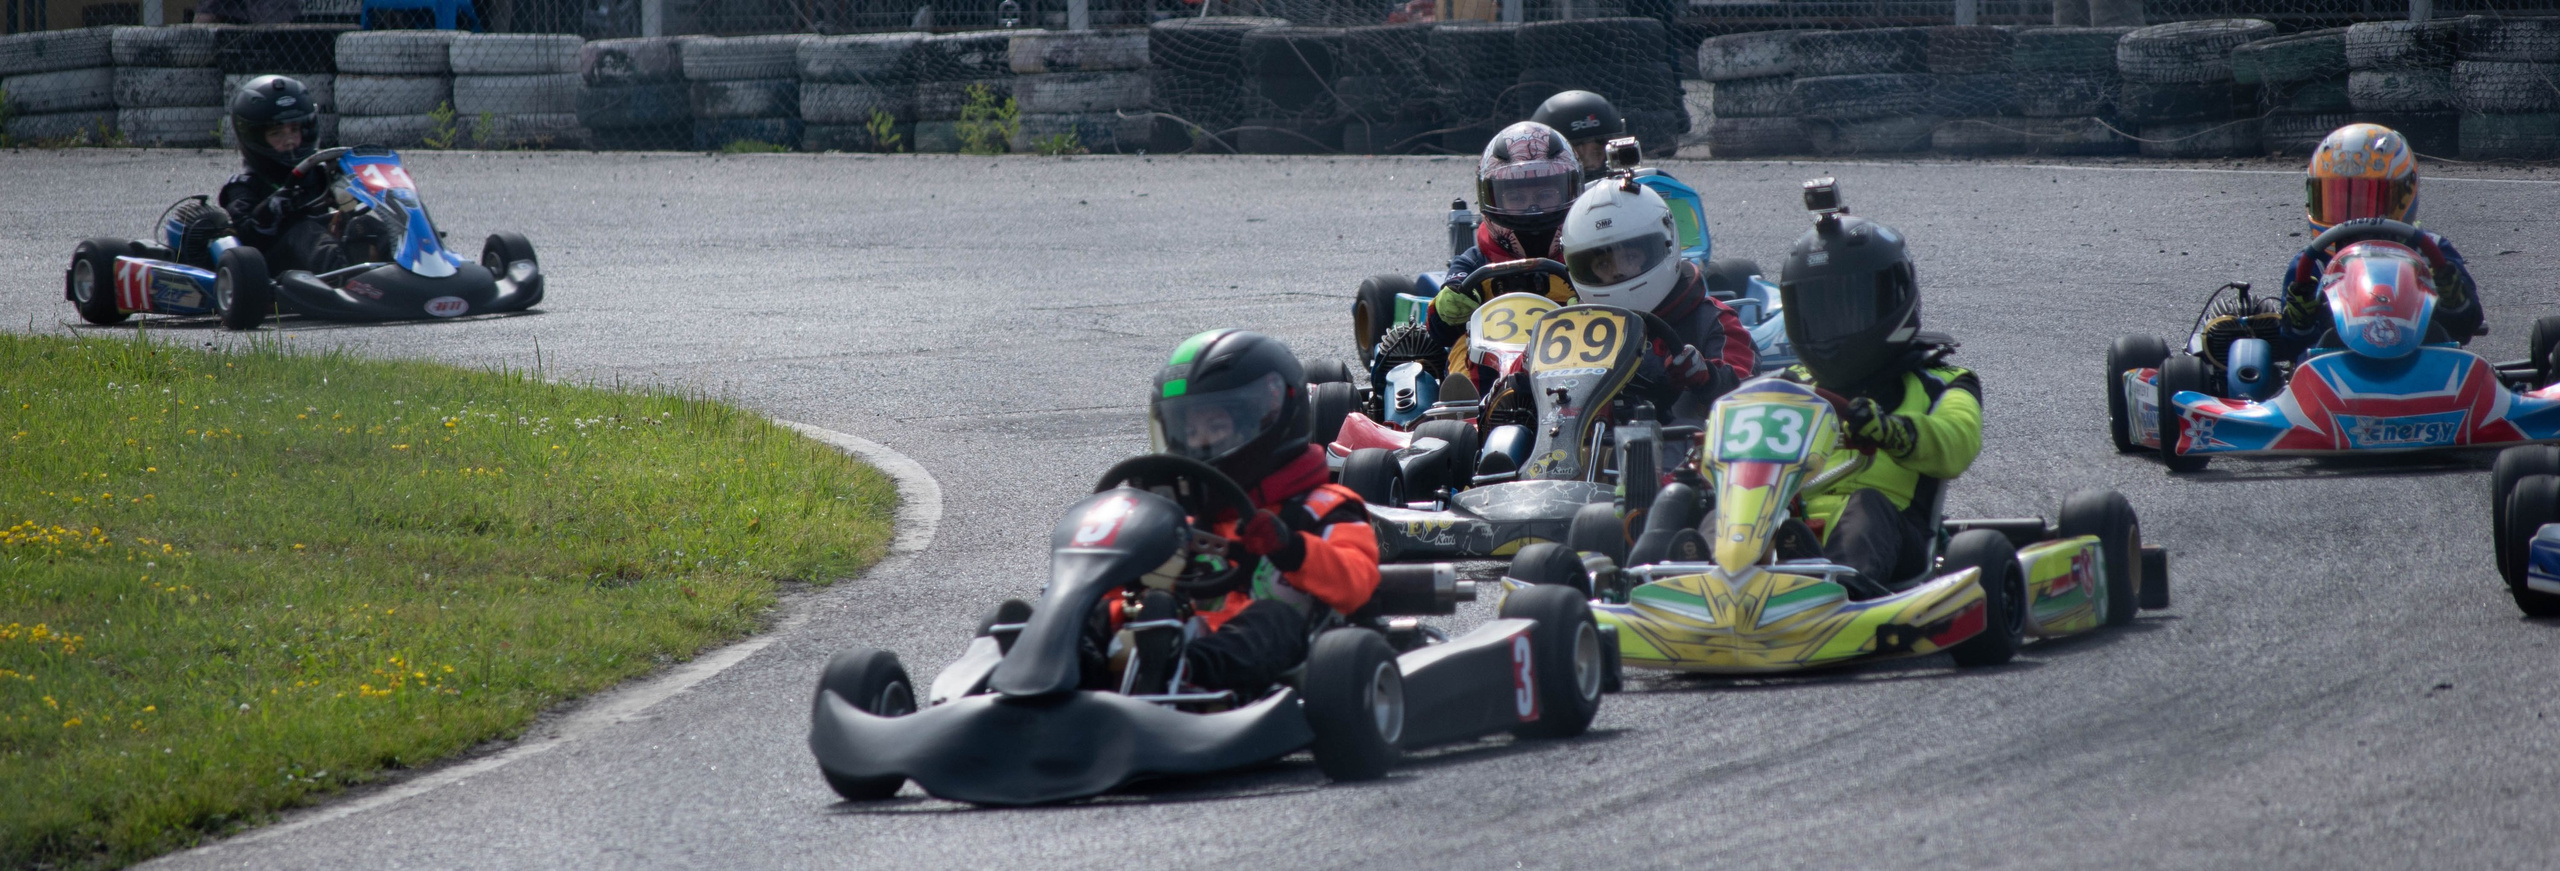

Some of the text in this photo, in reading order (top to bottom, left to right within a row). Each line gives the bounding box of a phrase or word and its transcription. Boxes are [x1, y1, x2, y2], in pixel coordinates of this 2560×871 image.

[362, 164, 416, 190] 11
[1595, 219, 1613, 230] OMP
[118, 261, 150, 309] 11
[1539, 317, 1617, 364] 69
[1725, 406, 1804, 453] 53
[1076, 499, 1132, 543] 3
[1514, 635, 1534, 716] 3
